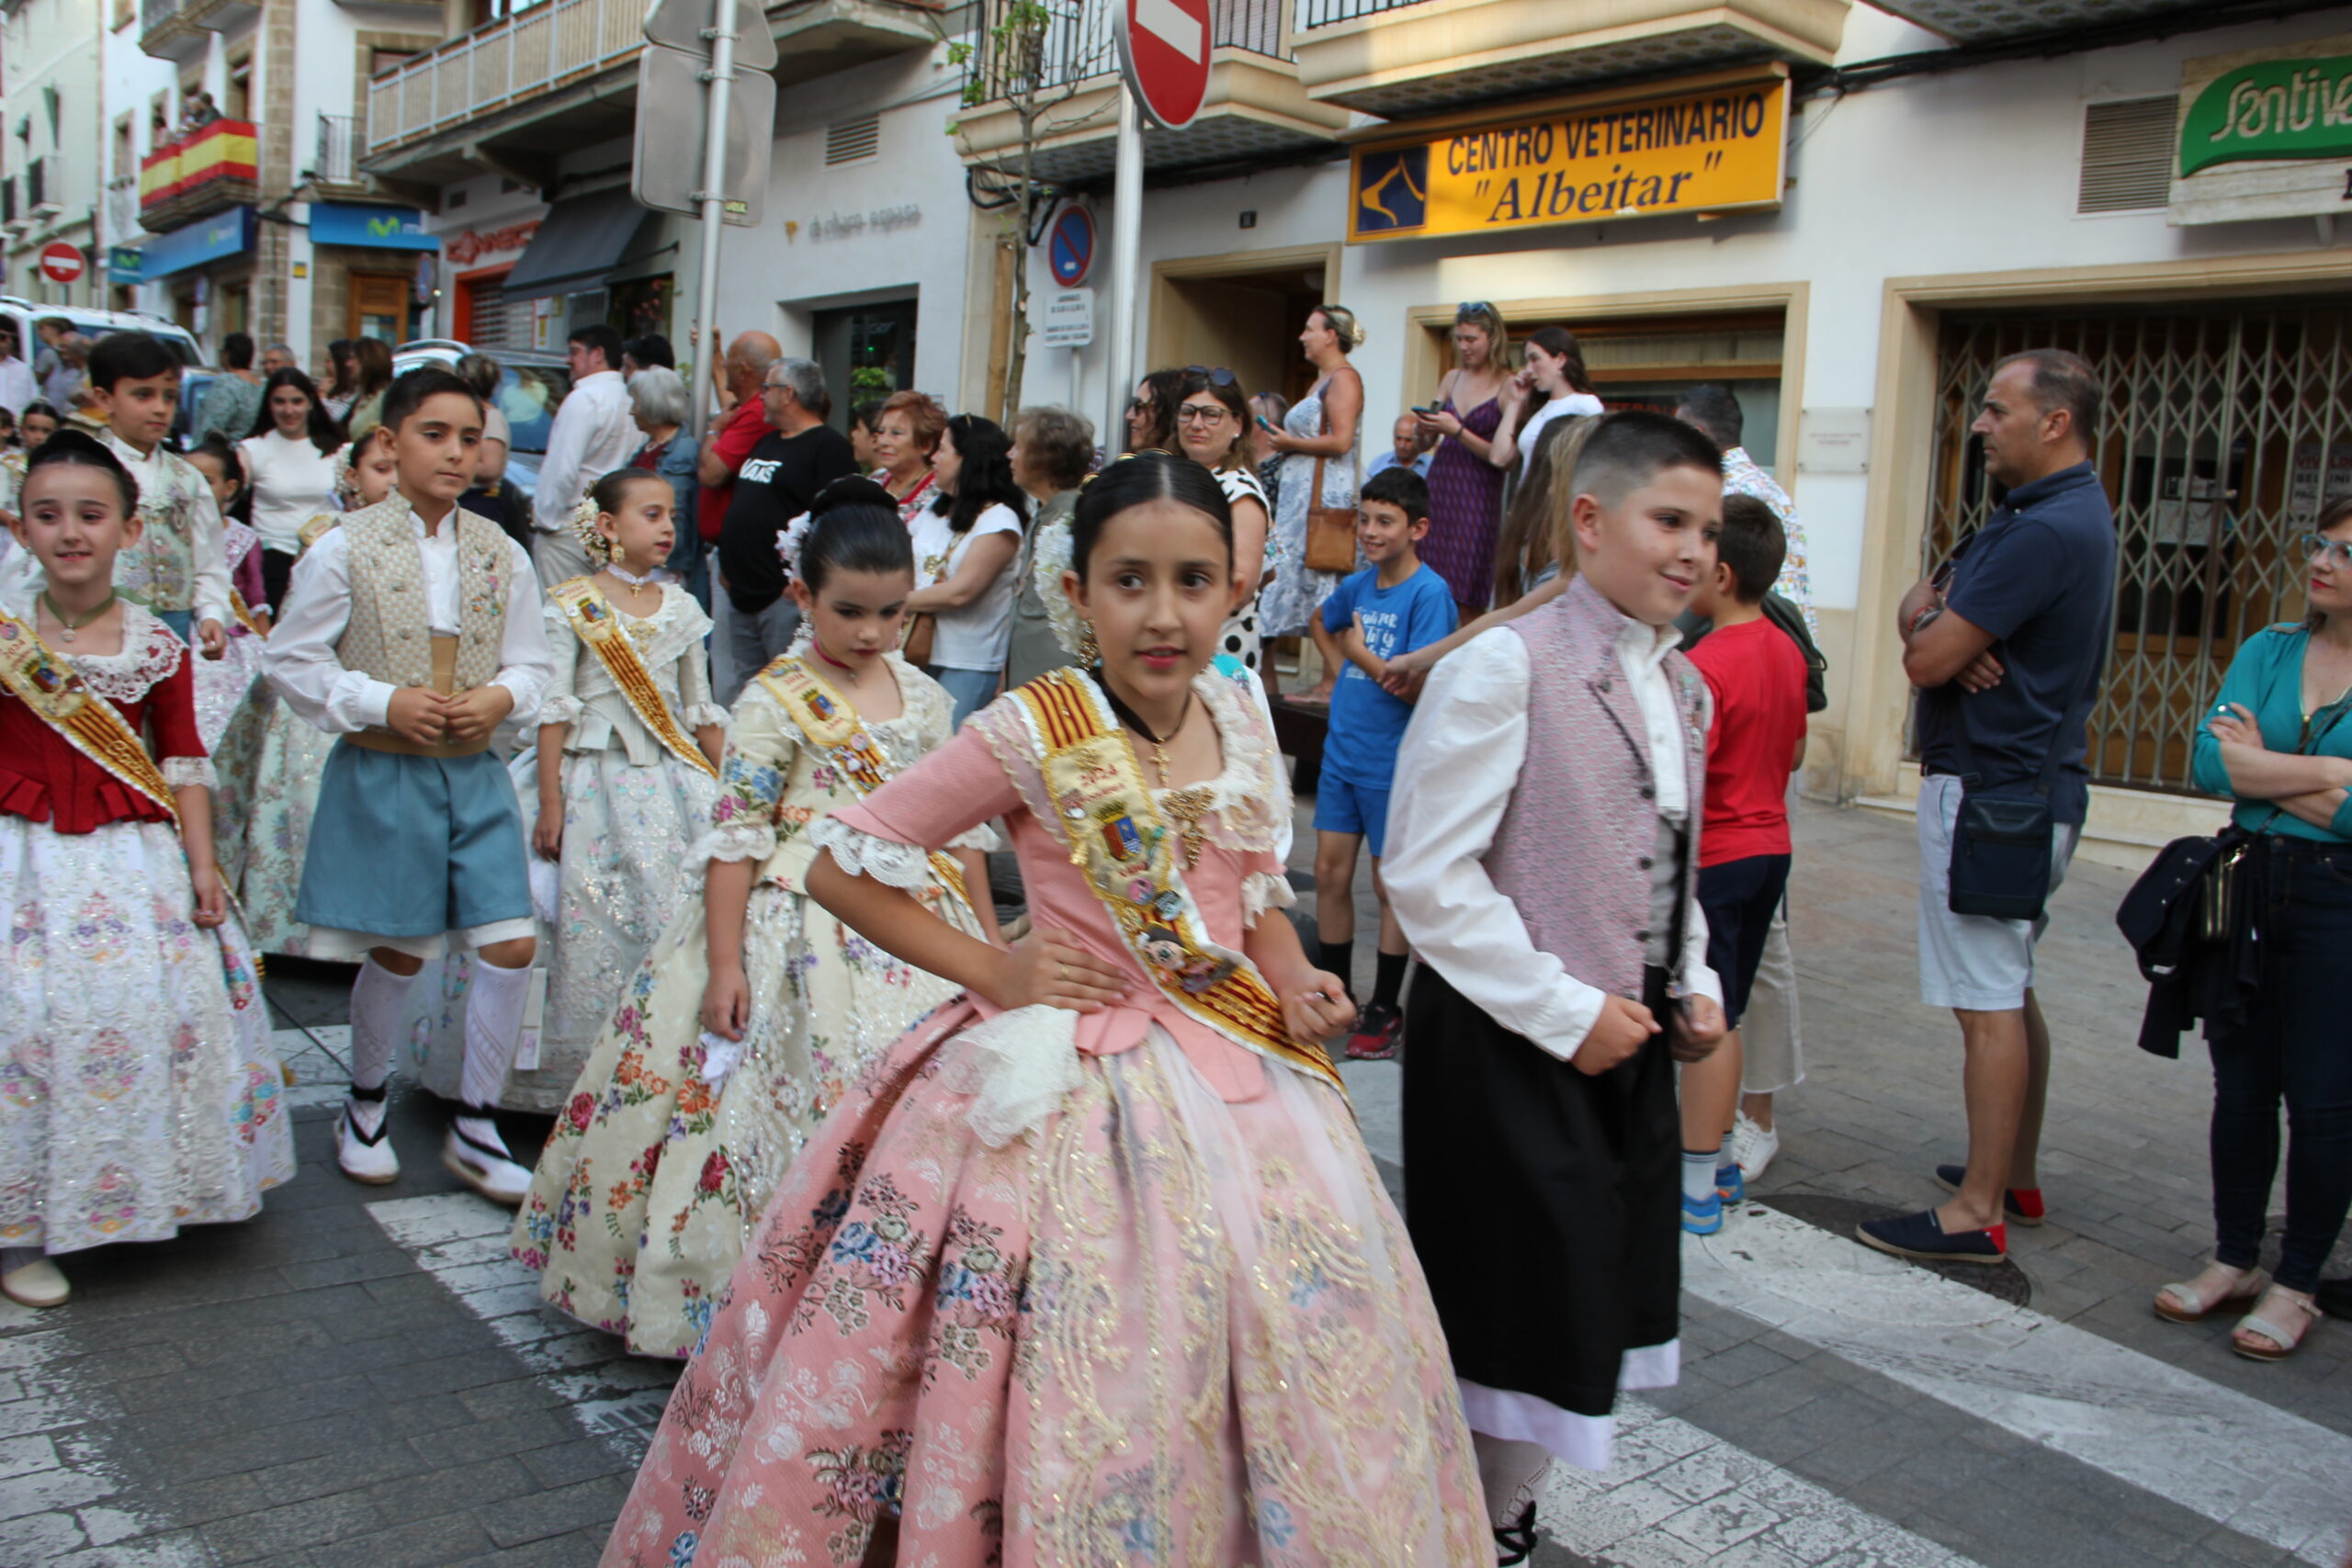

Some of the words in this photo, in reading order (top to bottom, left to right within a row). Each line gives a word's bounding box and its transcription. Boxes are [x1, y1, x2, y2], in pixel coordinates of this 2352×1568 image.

[1446, 122, 1555, 176] CENTRO
[1565, 92, 1765, 160] VETERINARIO
[739, 457, 783, 485] VANS
